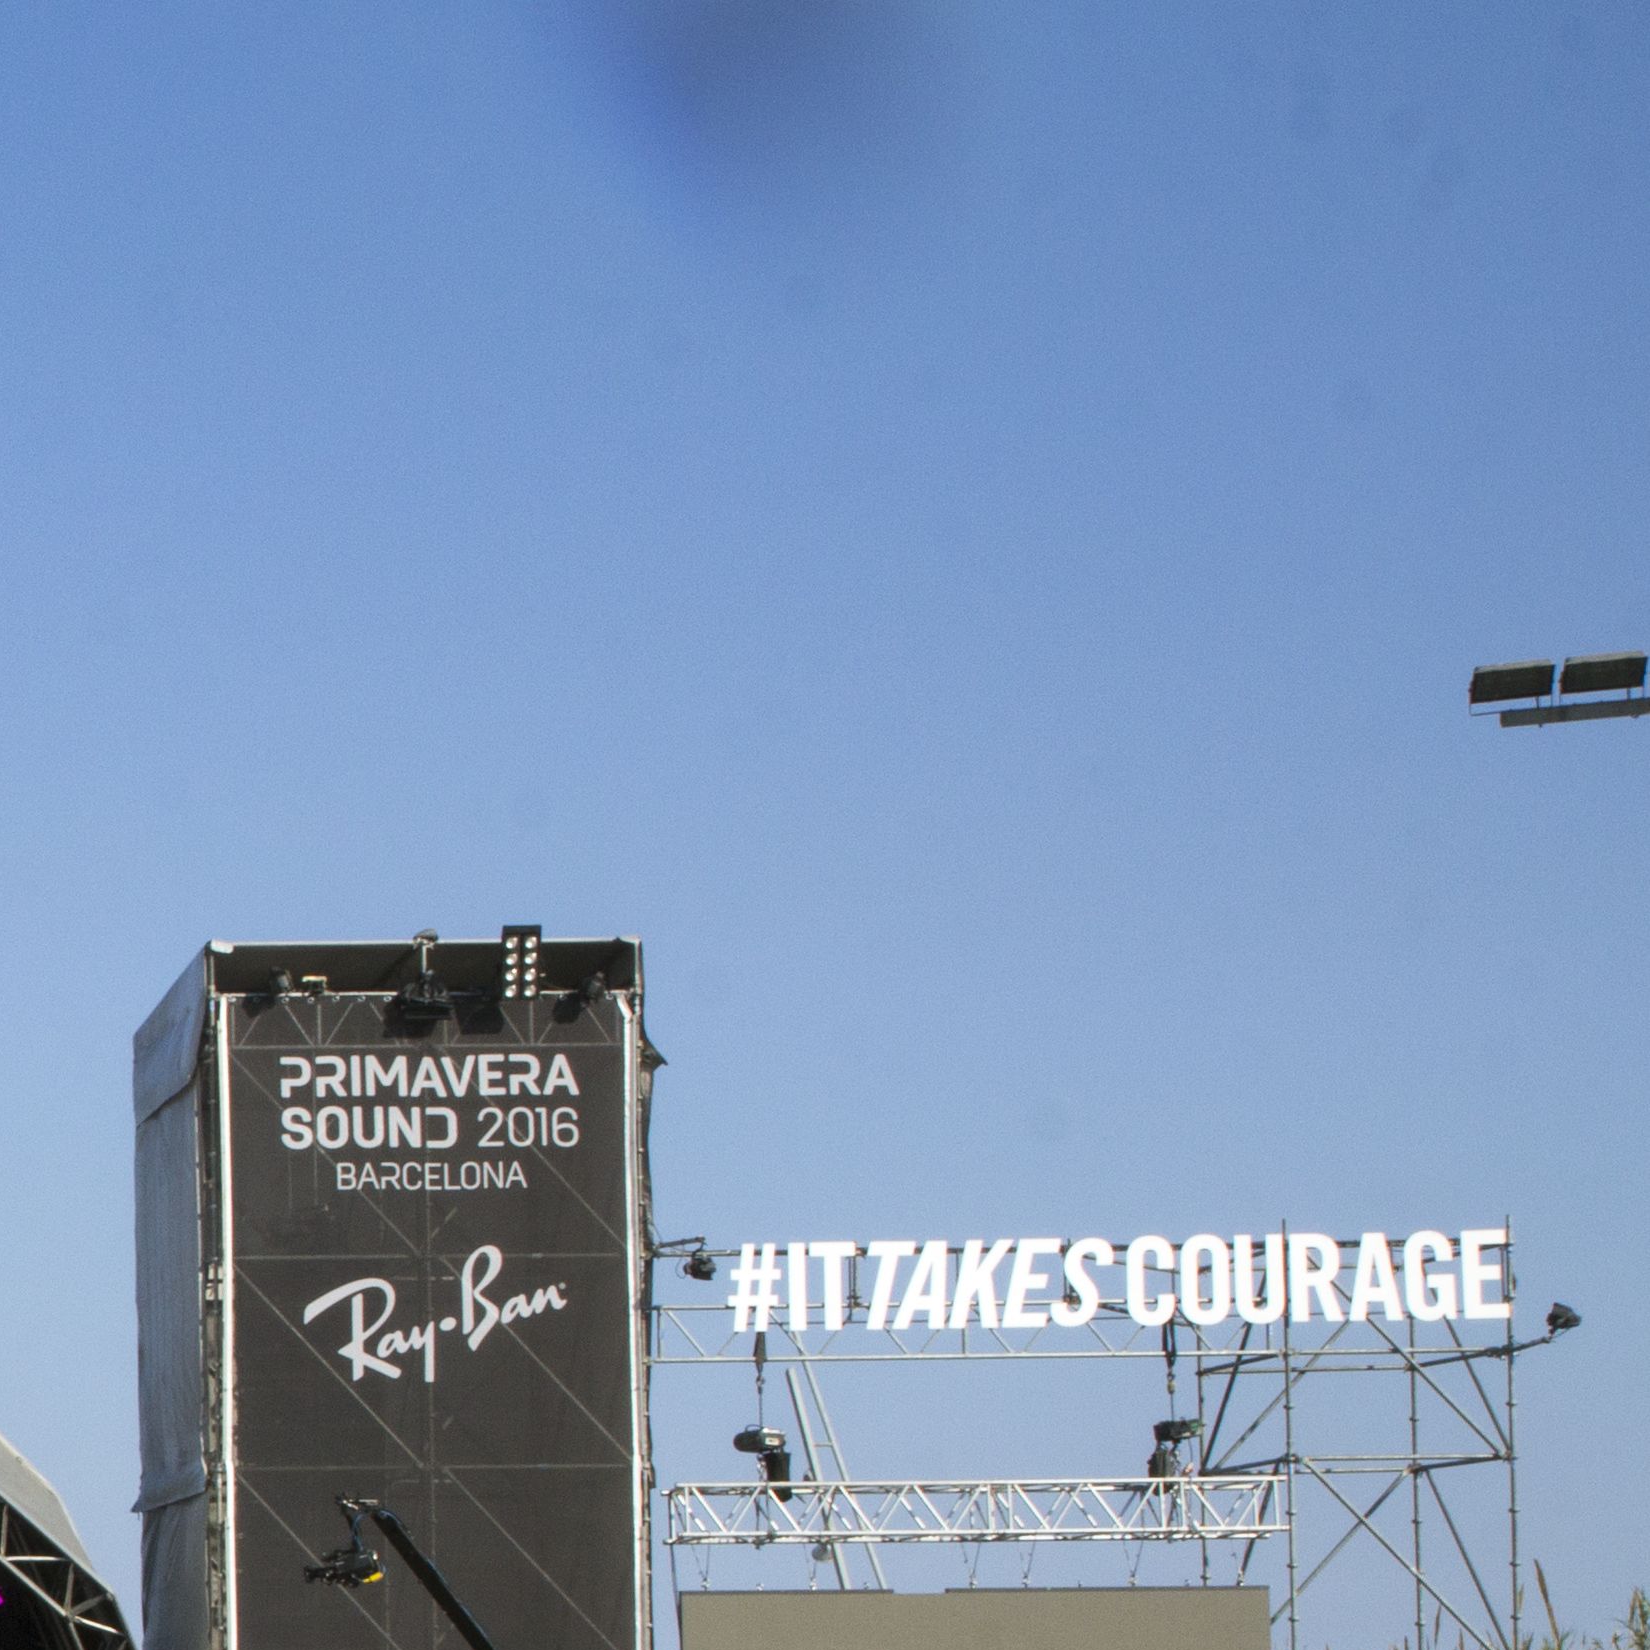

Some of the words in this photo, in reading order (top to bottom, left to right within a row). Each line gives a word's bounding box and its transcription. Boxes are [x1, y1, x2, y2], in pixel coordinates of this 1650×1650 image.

[279, 1053, 579, 1098] PRIMAVERA
[280, 1105, 458, 1150] SOUND
[477, 1106, 579, 1148] 2016
[336, 1160, 528, 1191] BARCELONA
